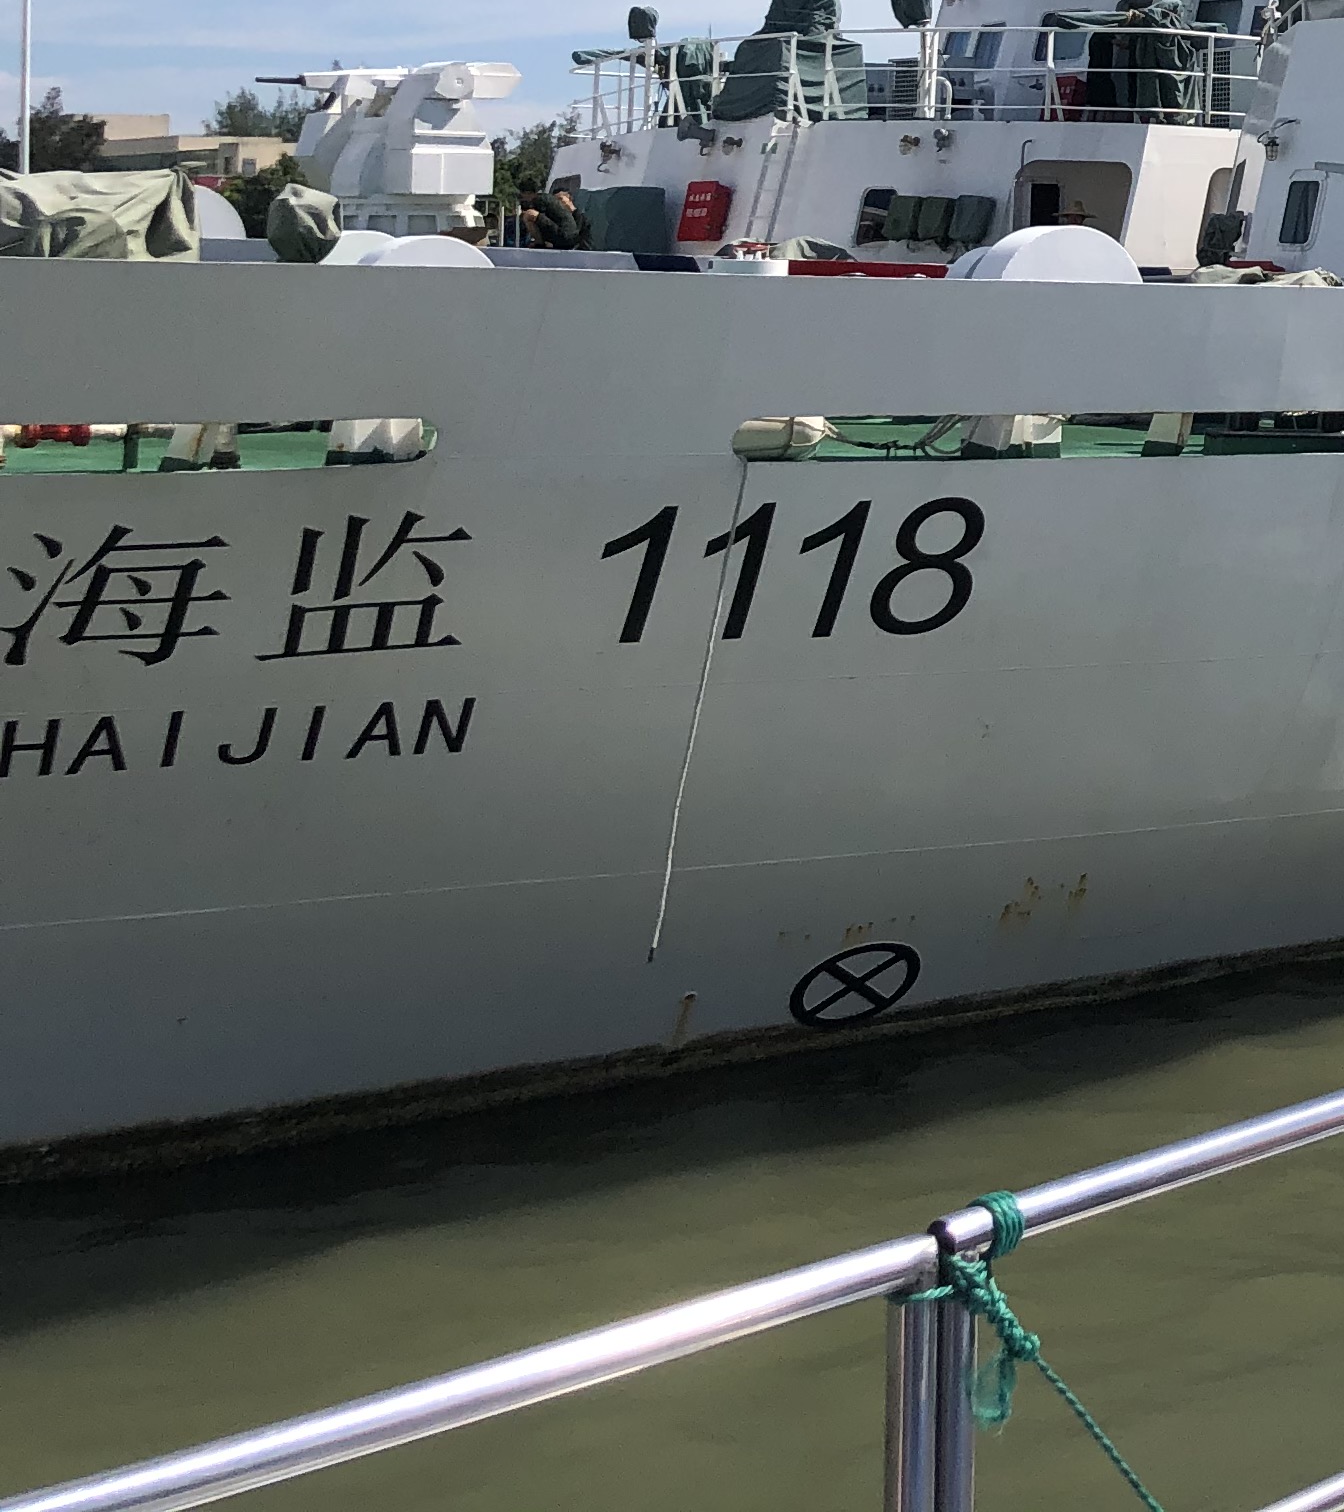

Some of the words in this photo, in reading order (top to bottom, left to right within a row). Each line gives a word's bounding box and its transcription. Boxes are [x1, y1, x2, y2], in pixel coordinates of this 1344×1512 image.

[0, 510, 473, 667] 海监
[600, 496, 985, 644] 1118
[0, 697, 476, 779] HAIJIAN
